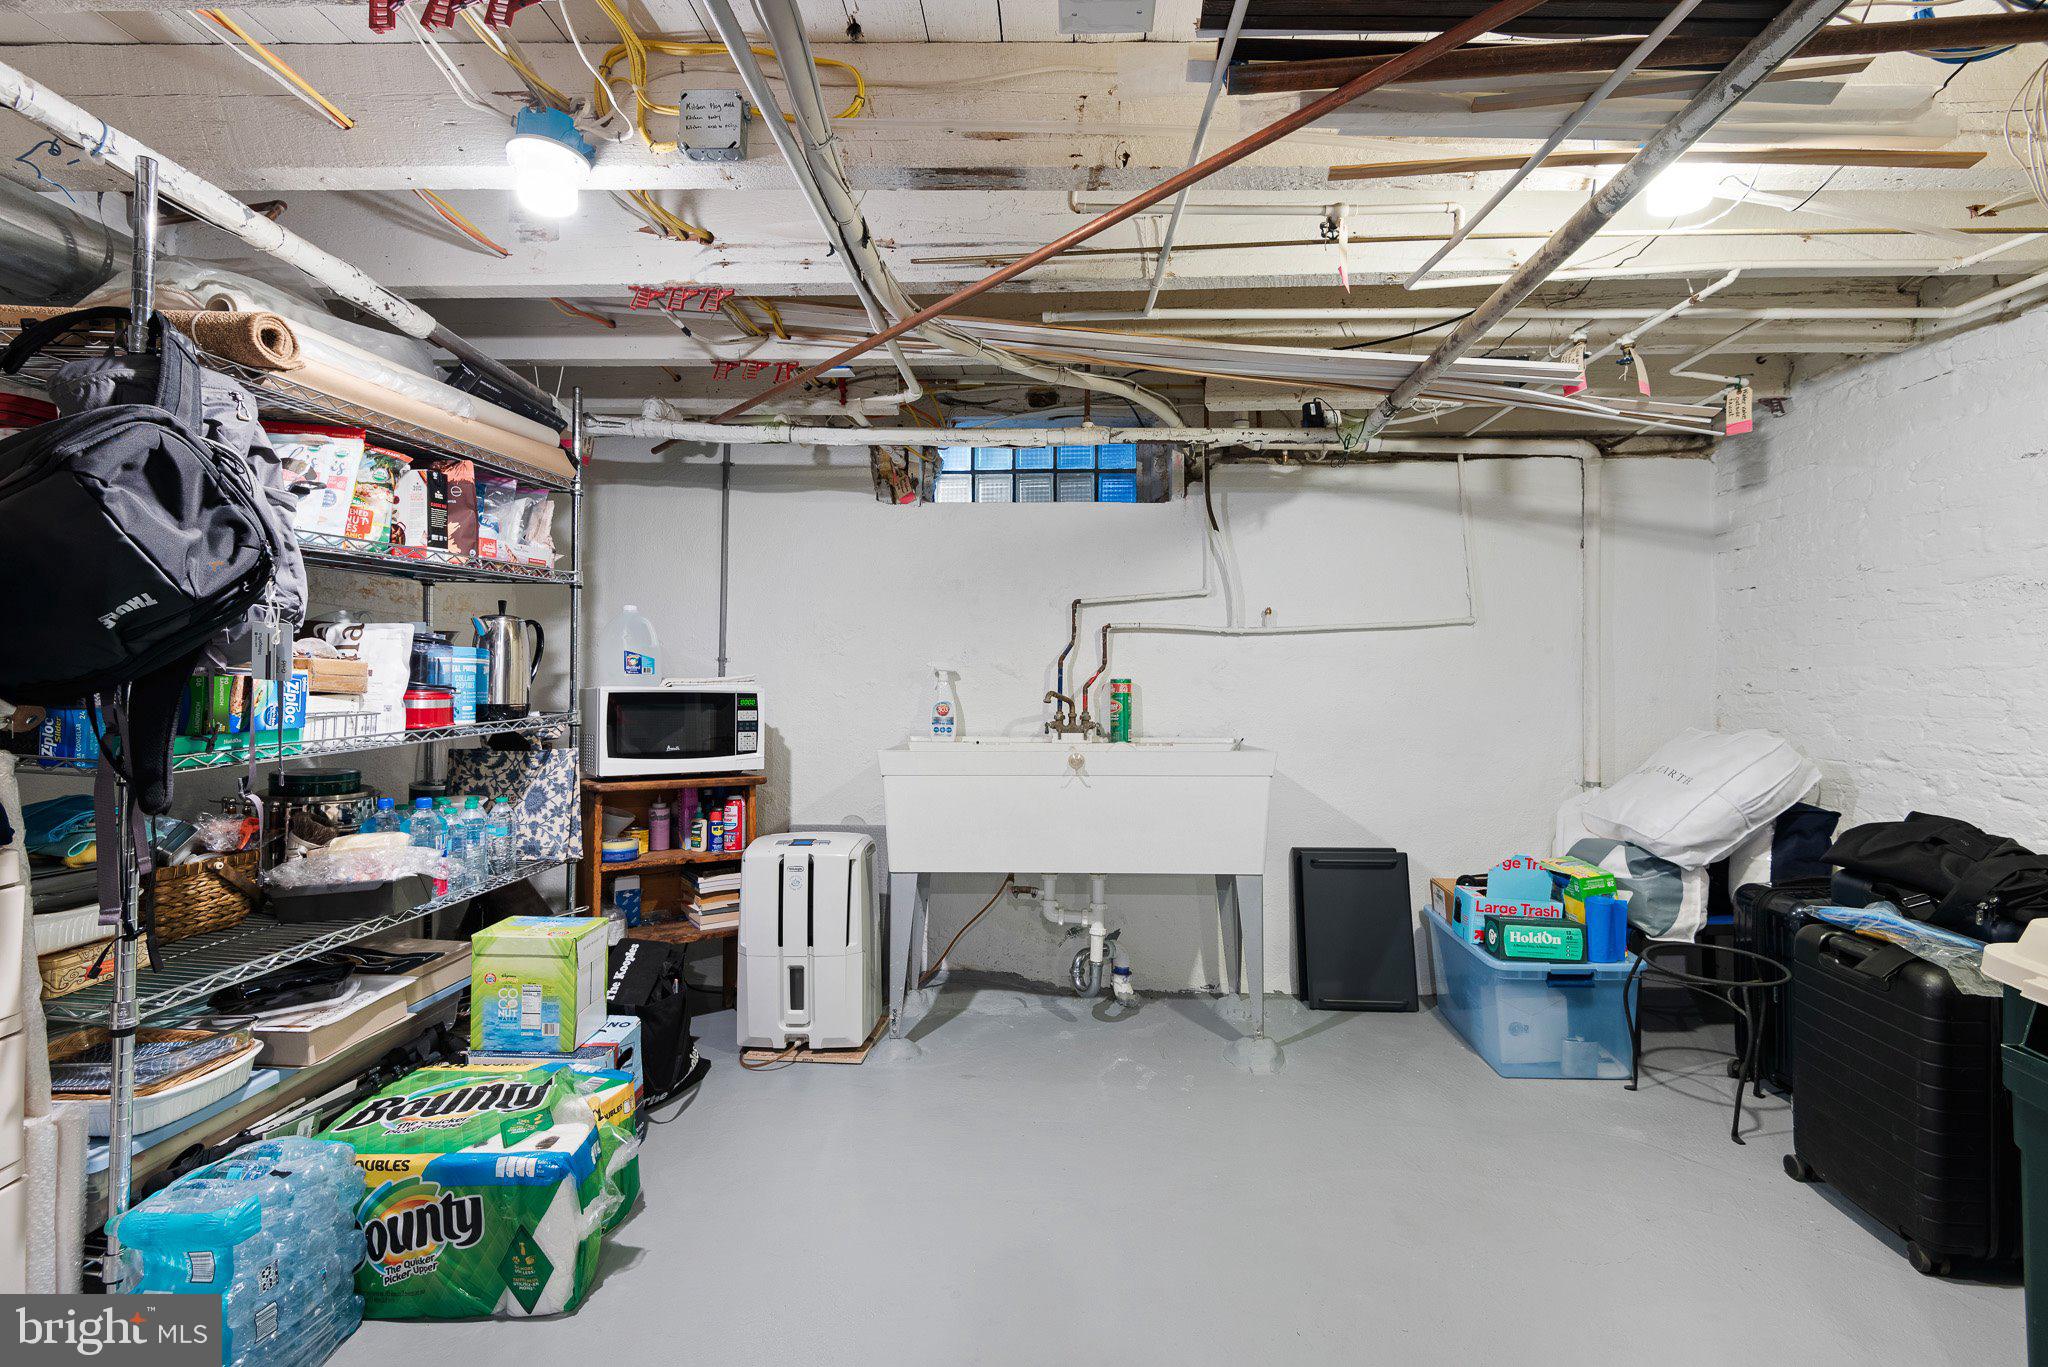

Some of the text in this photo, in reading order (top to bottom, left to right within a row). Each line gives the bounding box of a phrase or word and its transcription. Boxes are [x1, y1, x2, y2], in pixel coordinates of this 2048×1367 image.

[0, 320, 21, 329] Bakin
[284, 681, 300, 725] Ziploc
[41, 717, 58, 758] Ziploc
[1475, 900, 1561, 918] Large Trash
[1509, 930, 1562, 945] HoldOn
[613, 943, 640, 981] Kooples
[333, 1078, 554, 1133] Bounty
[355, 1159, 411, 1172] OUBLES
[355, 1191, 485, 1274] ounty
[384, 1262, 438, 1286] Picker Upper
[385, 1265, 401, 1275] The
